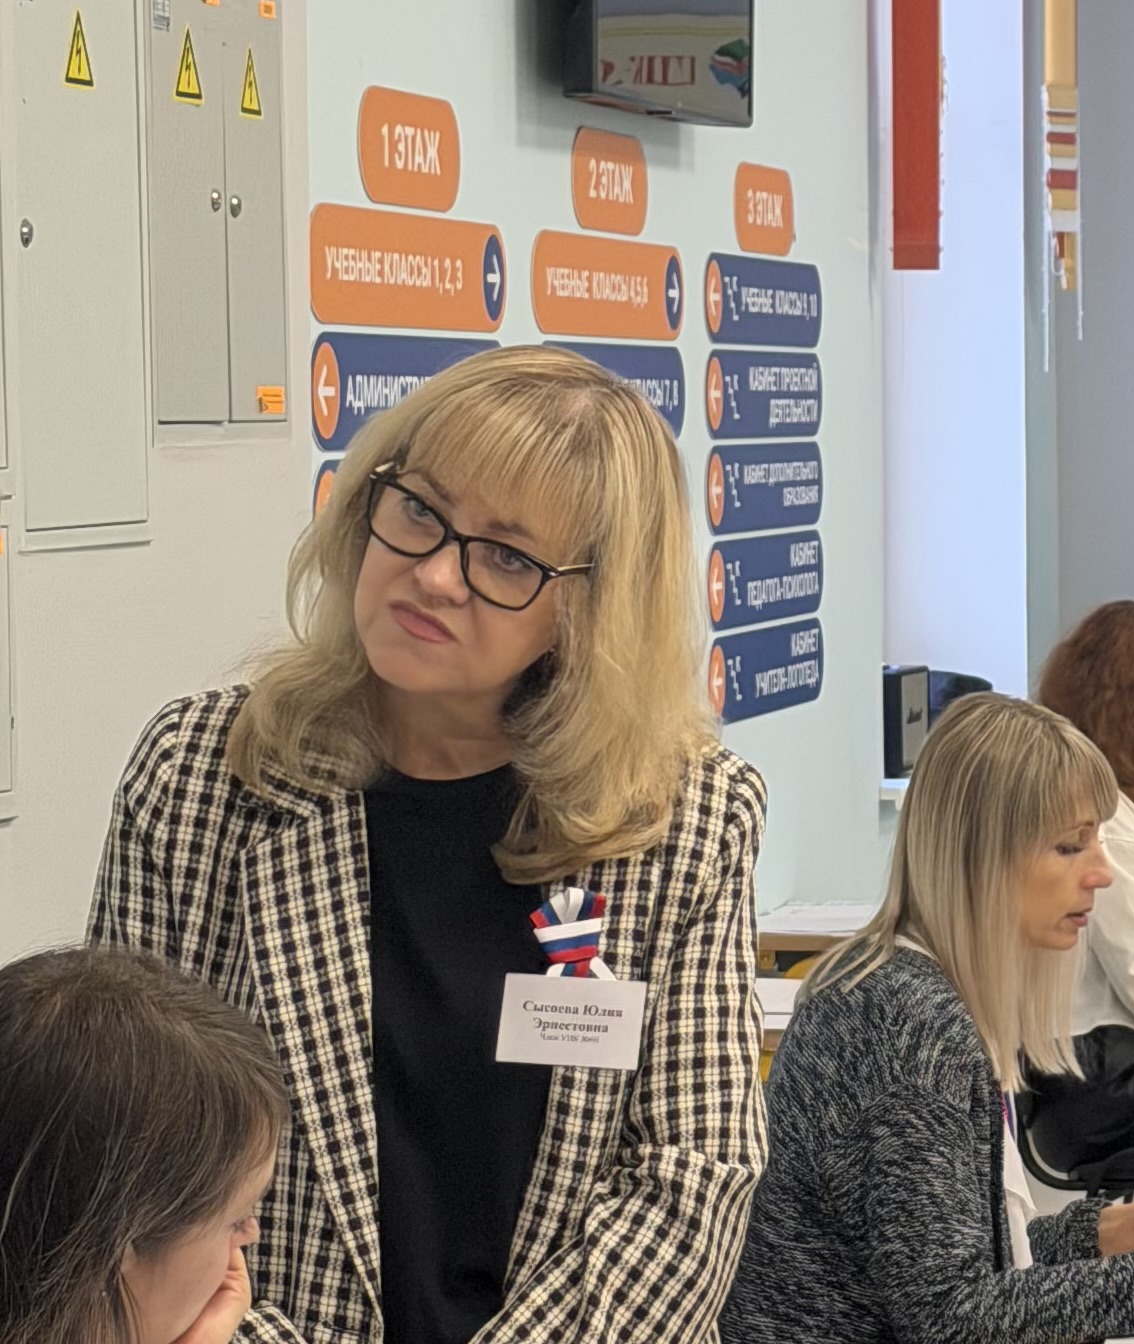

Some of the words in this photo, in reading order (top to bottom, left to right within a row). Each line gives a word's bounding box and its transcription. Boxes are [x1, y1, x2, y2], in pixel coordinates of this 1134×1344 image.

[381, 123, 389, 167] 1
[394, 124, 441, 176] ЭТАЖ
[589, 158, 597, 198] 2
[599, 160, 633, 204] ЭТАЖ
[747, 188, 755, 224] 3
[756, 191, 783, 228] ЭТАЖ
[325, 245, 382, 284] УЧЕБНЫЕ
[383, 252, 432, 288] КЛАССЫ
[456, 259, 463, 290] 3
[546, 266, 590, 299] УЧЕБНЫЕ
[592, 271, 629, 303] КЛАССЫ
[741, 287, 773, 314] УЧЕБНЫЕ
[775, 289, 803, 317] КЛАССЫ
[345, 374, 432, 416] АДМИНИСТР
[749, 366, 780, 391] КАБИНЕТ
[780, 362, 818, 392] ПРОЕКТНОЙ
[769, 398, 818, 429] ДЕЯТЕЛЬНОСТИ
[790, 540, 819, 567] КАБИНЕТ
[747, 571, 819, 611] ПЕДАГОГА-ПСИХОЛОГА
[791, 628, 819, 657] КАБИНЕТ
[755, 658, 819, 698] УЧИТЕЛЯ-ЛОГОПЕДА
[583, 1004, 624, 1017] Юлия
